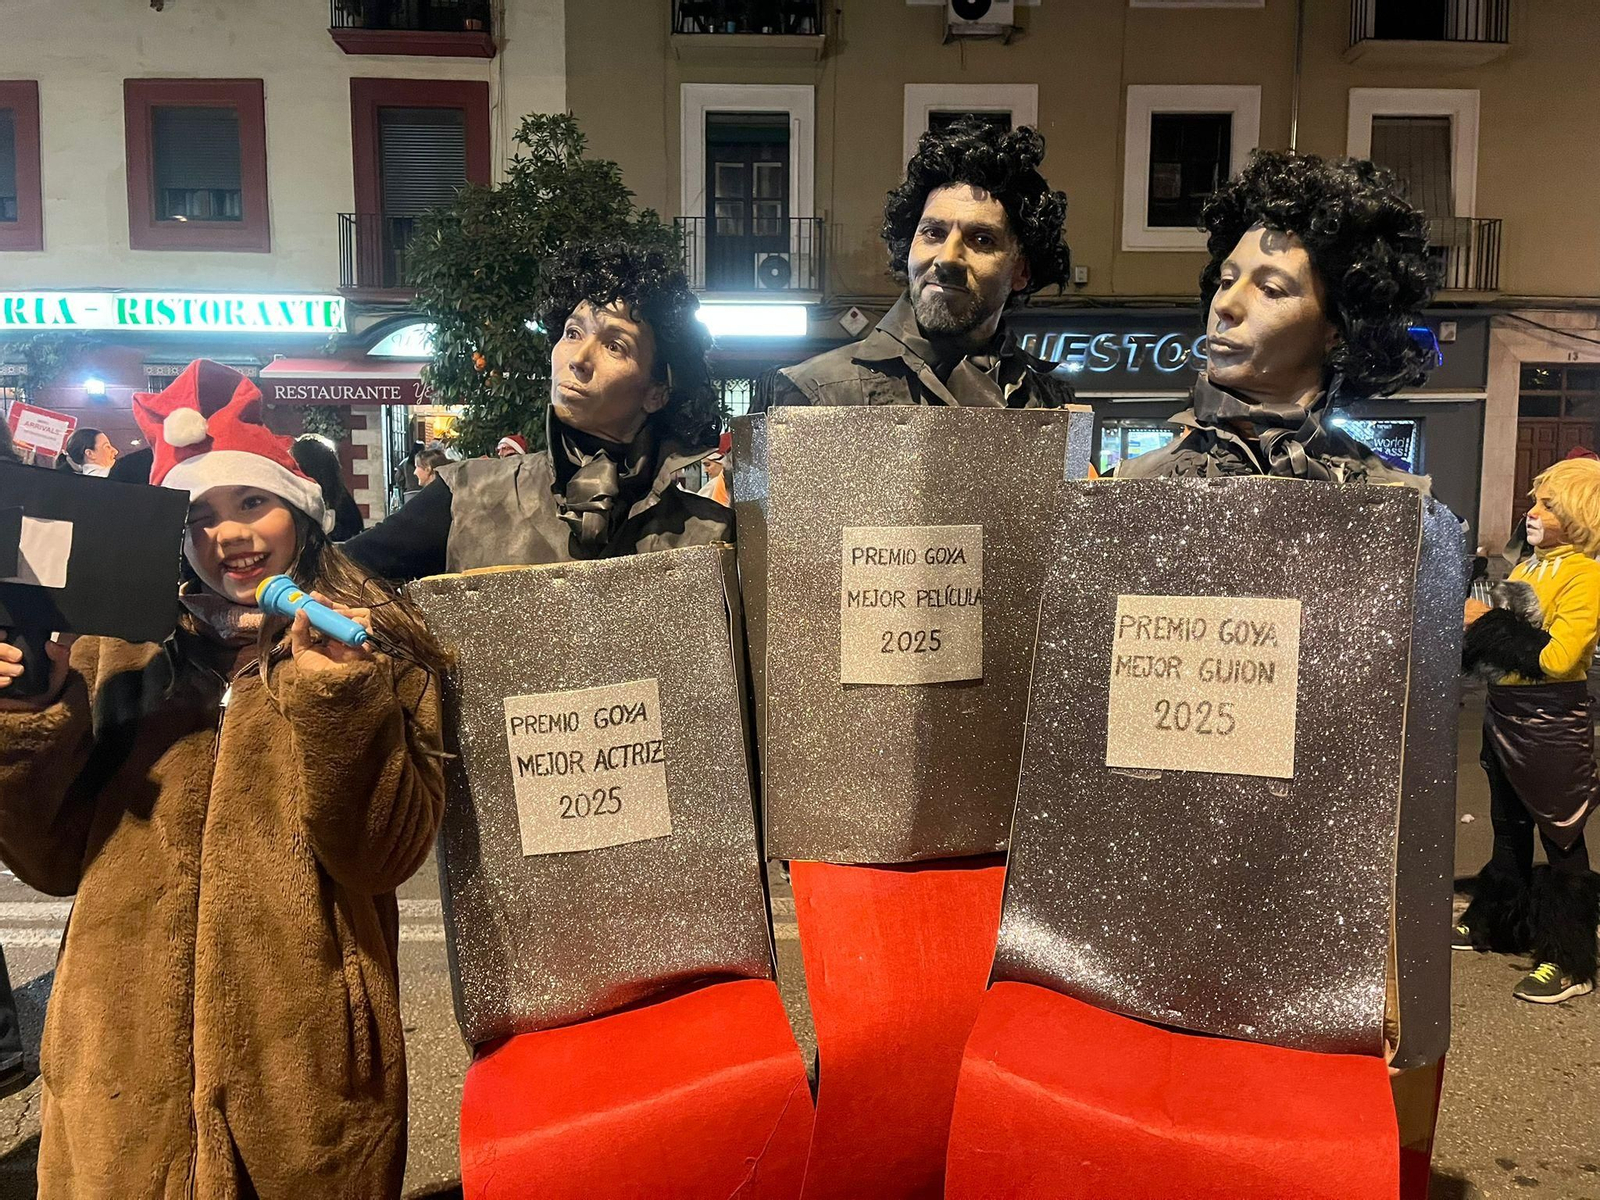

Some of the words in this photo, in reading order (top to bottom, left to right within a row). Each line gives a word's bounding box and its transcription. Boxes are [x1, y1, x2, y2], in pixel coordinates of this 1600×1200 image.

[4, 297, 76, 324] RIA
[116, 298, 341, 327] RISTORANTE
[274, 385, 401, 400] RESTAURANTE
[851, 547, 917, 566] PREMIO
[924, 547, 967, 565] GOYA
[847, 589, 906, 608] MEJOR
[916, 584, 983, 608] PELÍCULA
[881, 629, 942, 653] 2025
[1118, 614, 1208, 642] PREMIO
[1218, 618, 1278, 647] GOYA
[1115, 655, 1183, 680] MEJOR
[510, 711, 580, 736] PREMIO
[594, 701, 648, 730] GOYA
[1154, 699, 1236, 735] 2025
[517, 750, 585, 778] MEJOR
[593, 739, 665, 772] ACTRIZ
[558, 786, 623, 819] 2025
